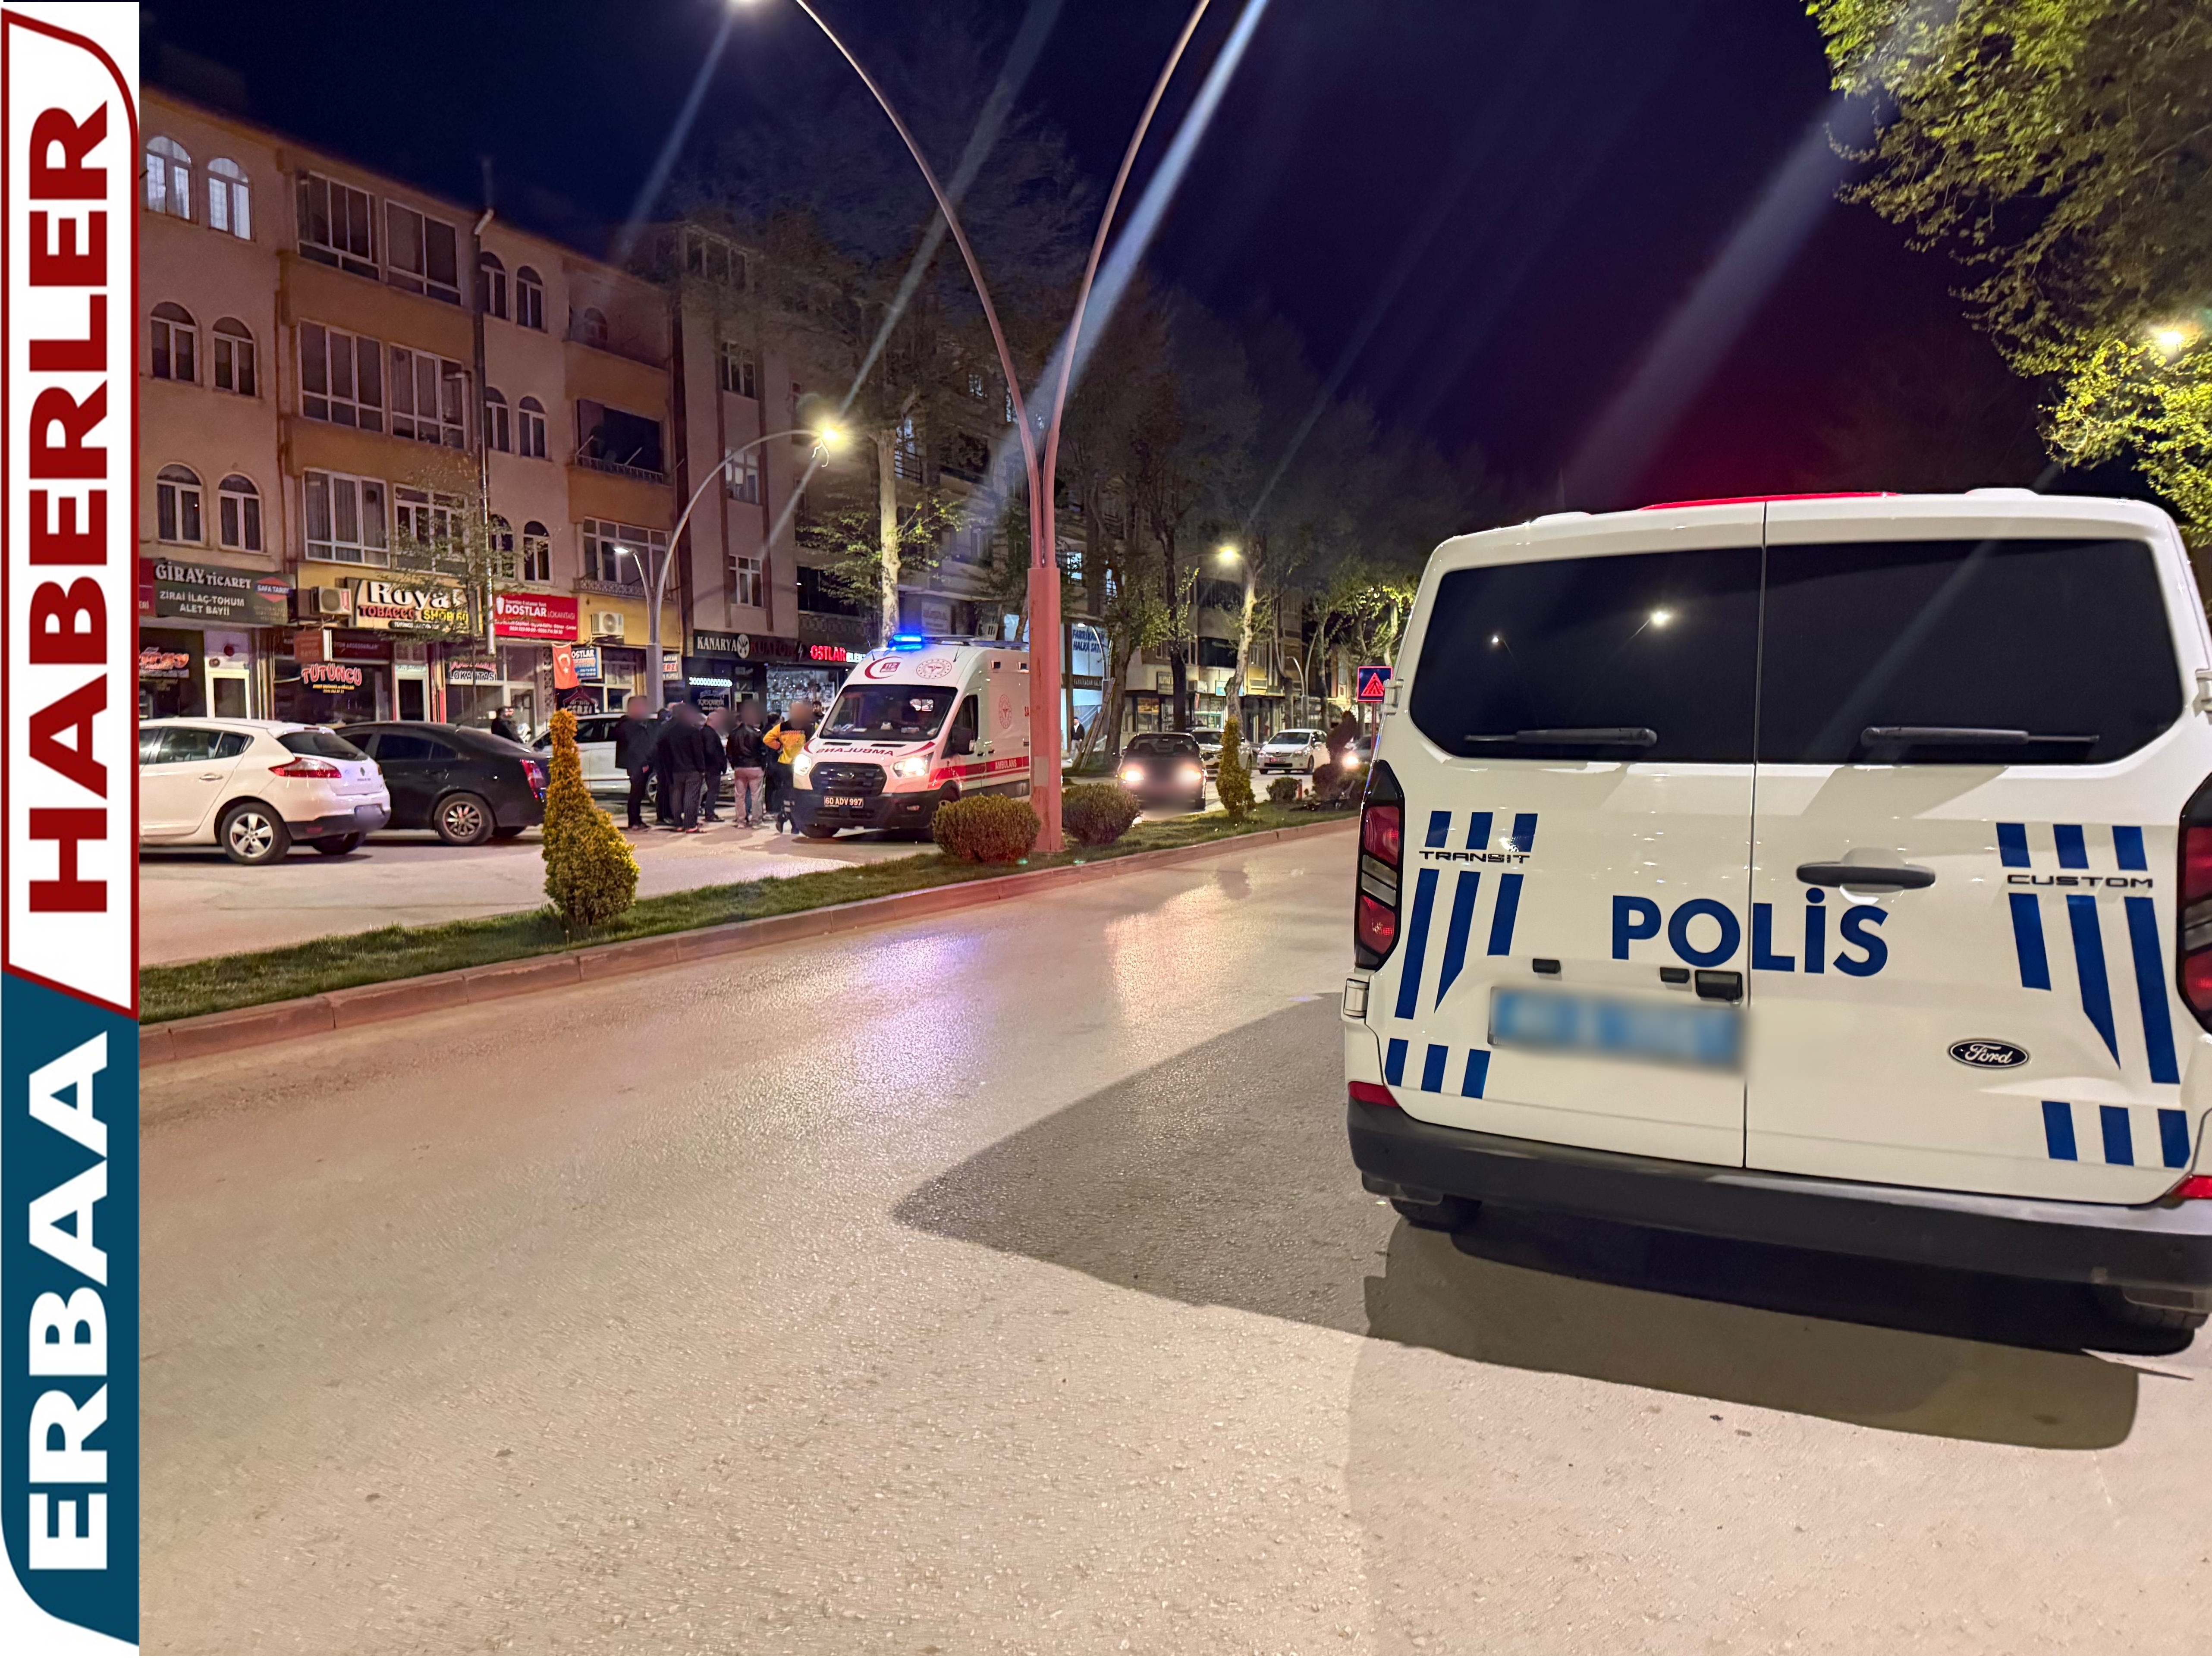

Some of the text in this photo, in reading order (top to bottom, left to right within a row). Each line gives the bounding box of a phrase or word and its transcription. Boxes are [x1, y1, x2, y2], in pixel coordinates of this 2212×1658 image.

[155, 562, 251, 589] GİRAY TİCARET
[180, 603, 203, 614] ALET
[506, 605, 575, 620] DOSTLAR LOKANTASI
[697, 636, 737, 652] KANARYA
[571, 650, 594, 658] OSTLAR
[301, 663, 362, 686] TÜTÜNCÜ
[995, 758, 1017, 770] AMBULANS
[1419, 851, 1530, 864] TRANSIT
[2007, 875, 2153, 888] CUSTOM
[1612, 887, 1888, 977] POLİS
[1965, 1044, 2014, 1064] Ford
